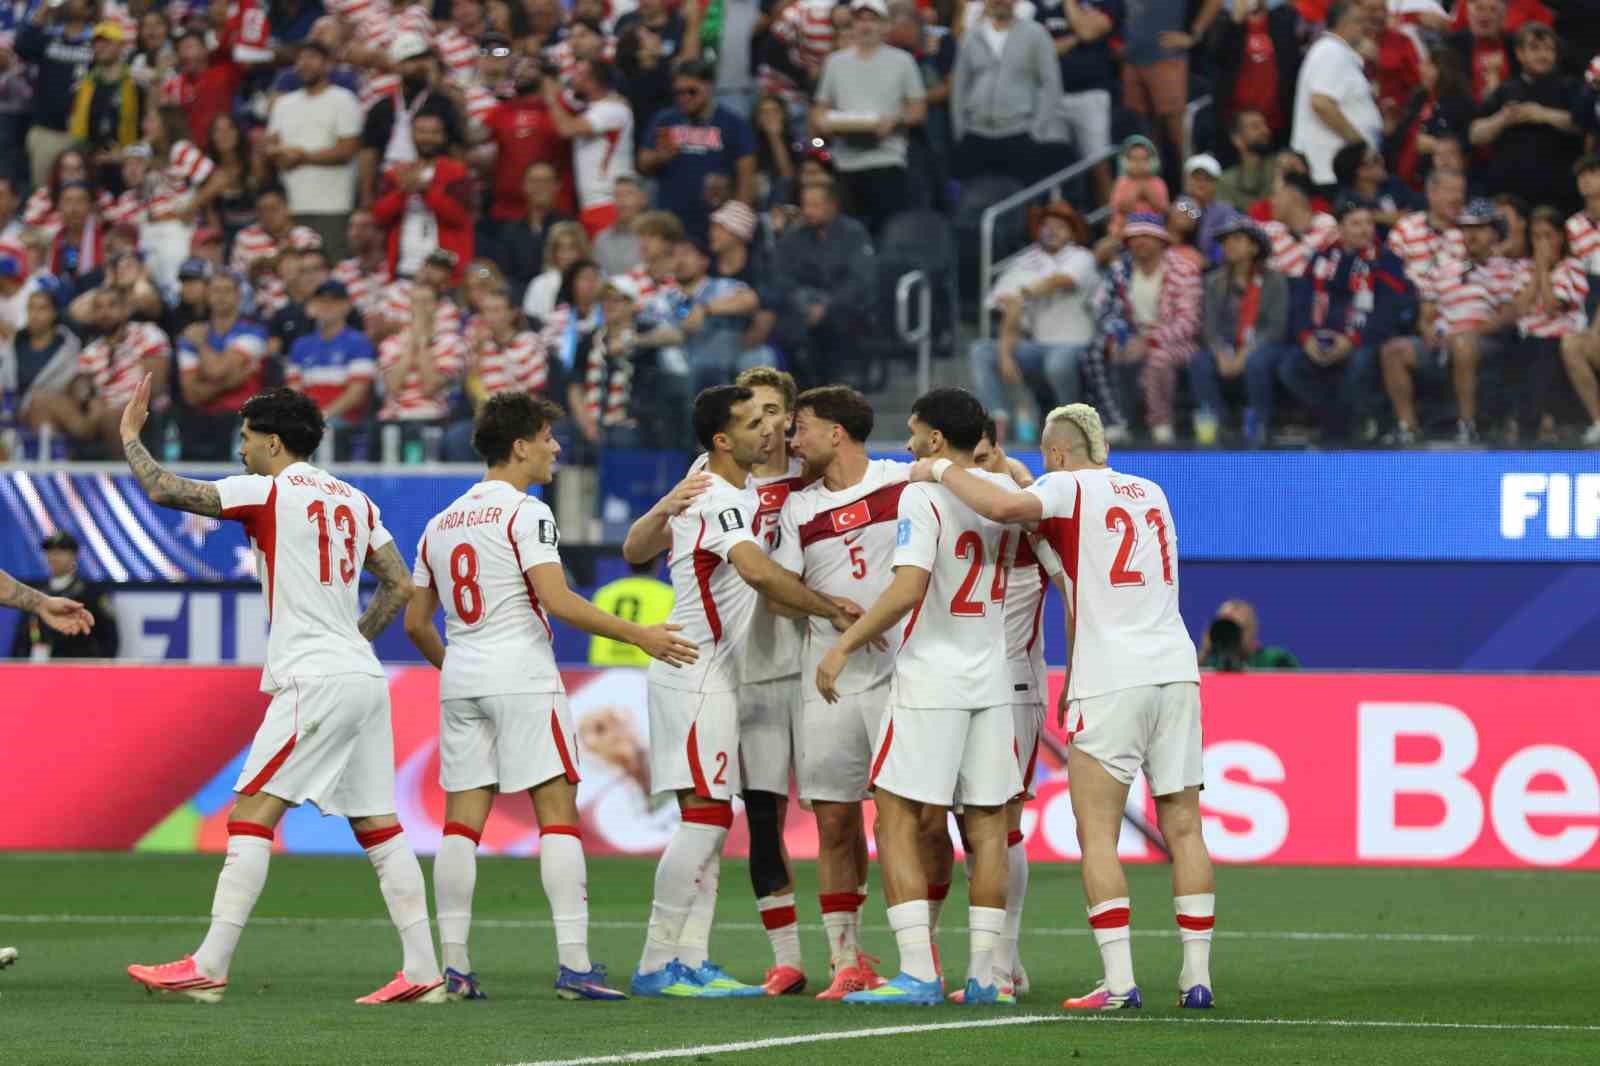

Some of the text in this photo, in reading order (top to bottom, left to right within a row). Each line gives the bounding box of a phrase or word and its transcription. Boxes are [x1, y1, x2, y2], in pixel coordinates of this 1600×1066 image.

[306, 499, 357, 587] 13
[450, 542, 486, 626] 8
[848, 546, 867, 580] 5
[1105, 506, 1174, 588] 21
[713, 751, 728, 785] 2
[1357, 701, 1600, 866] Be
